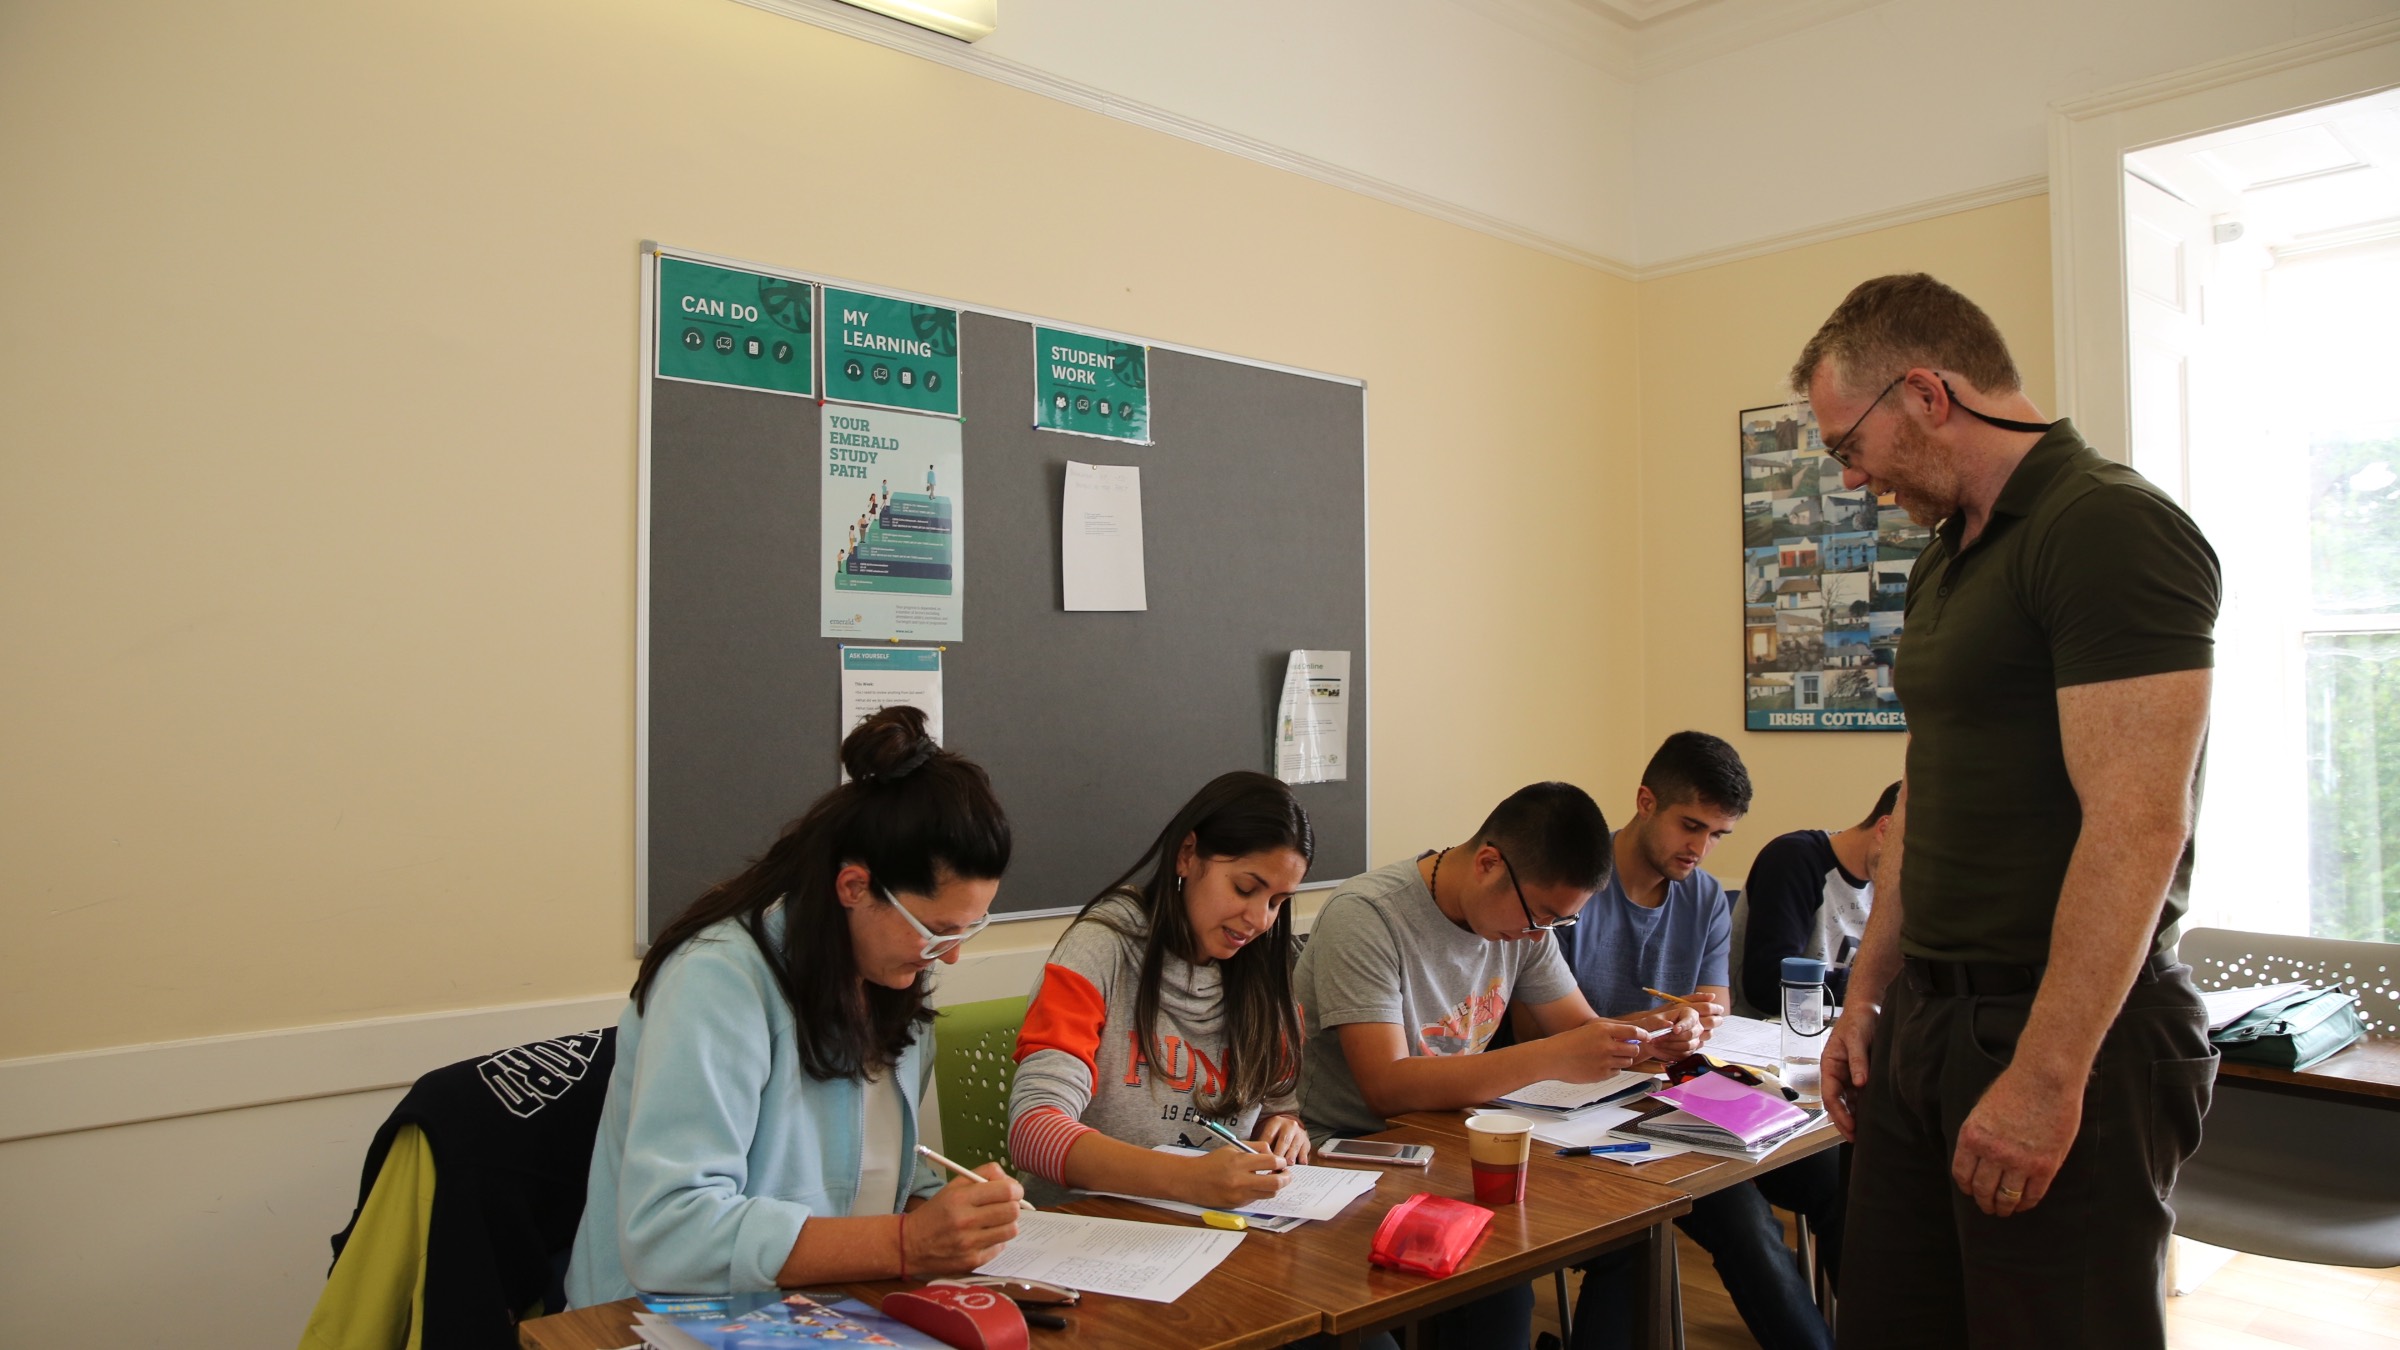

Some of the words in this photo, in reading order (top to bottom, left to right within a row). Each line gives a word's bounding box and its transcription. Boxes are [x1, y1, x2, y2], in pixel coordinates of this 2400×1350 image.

[681, 296, 724, 317] CAN
[730, 303, 758, 322] DO
[843, 309, 869, 327] MY
[843, 329, 931, 358] LEARNING
[1051, 346, 1115, 370] STUDENT
[1051, 364, 1096, 385] WORK
[829, 415, 870, 432] YOUR
[829, 431, 899, 451] EMERALD
[829, 447, 878, 464] STUDY
[829, 463, 867, 479] PATH
[1769, 712, 1815, 726] IRISH
[1821, 712, 1907, 726] COTTAGES
[477, 1028, 604, 1118] FORD
[1161, 1104, 1179, 1121] 19
